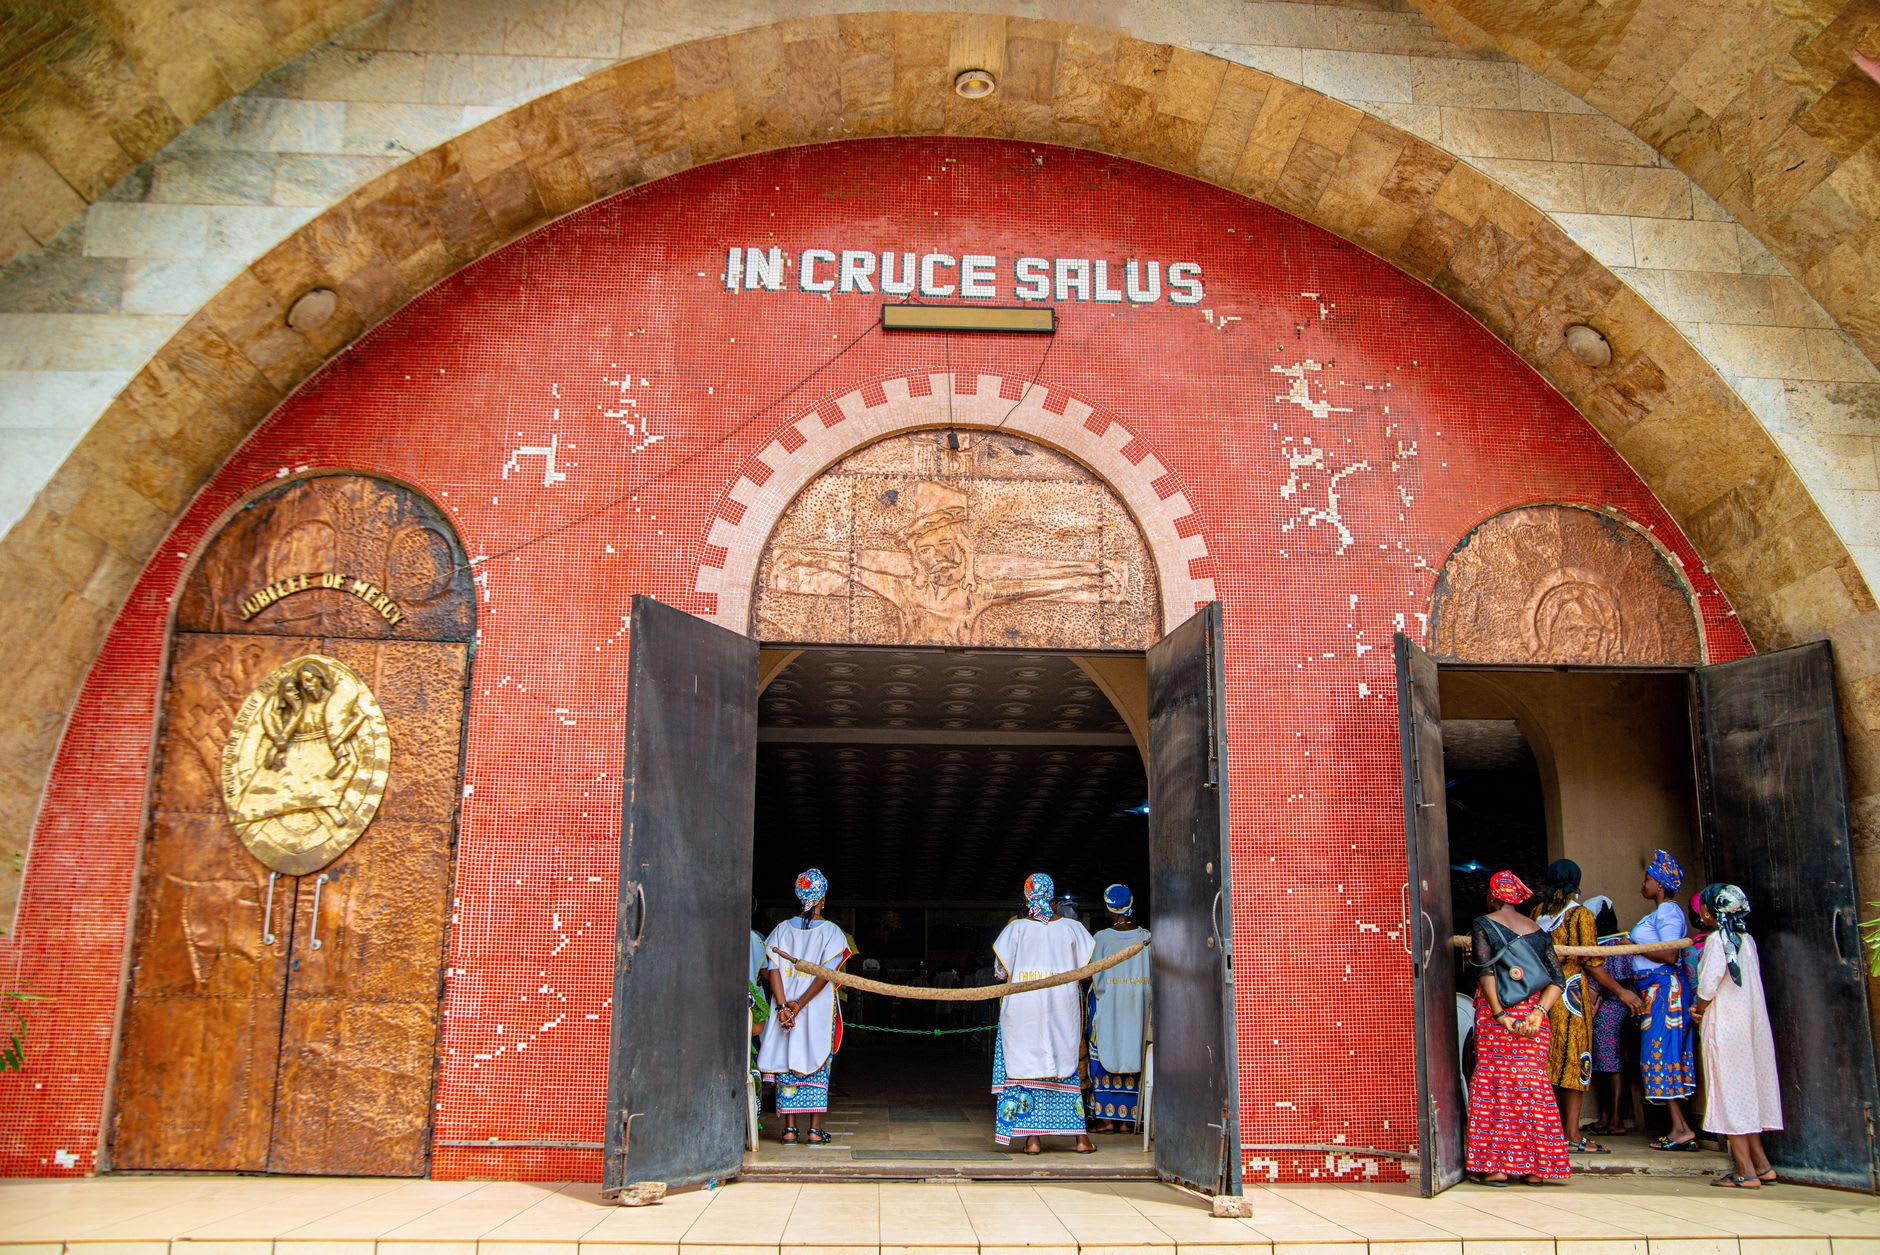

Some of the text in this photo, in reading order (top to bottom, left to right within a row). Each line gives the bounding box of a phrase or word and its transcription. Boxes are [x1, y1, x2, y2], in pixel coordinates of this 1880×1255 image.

[724, 247, 1205, 305] IN CRUCE SALUS
[240, 572, 406, 627] JUBILEE OF MERCY
